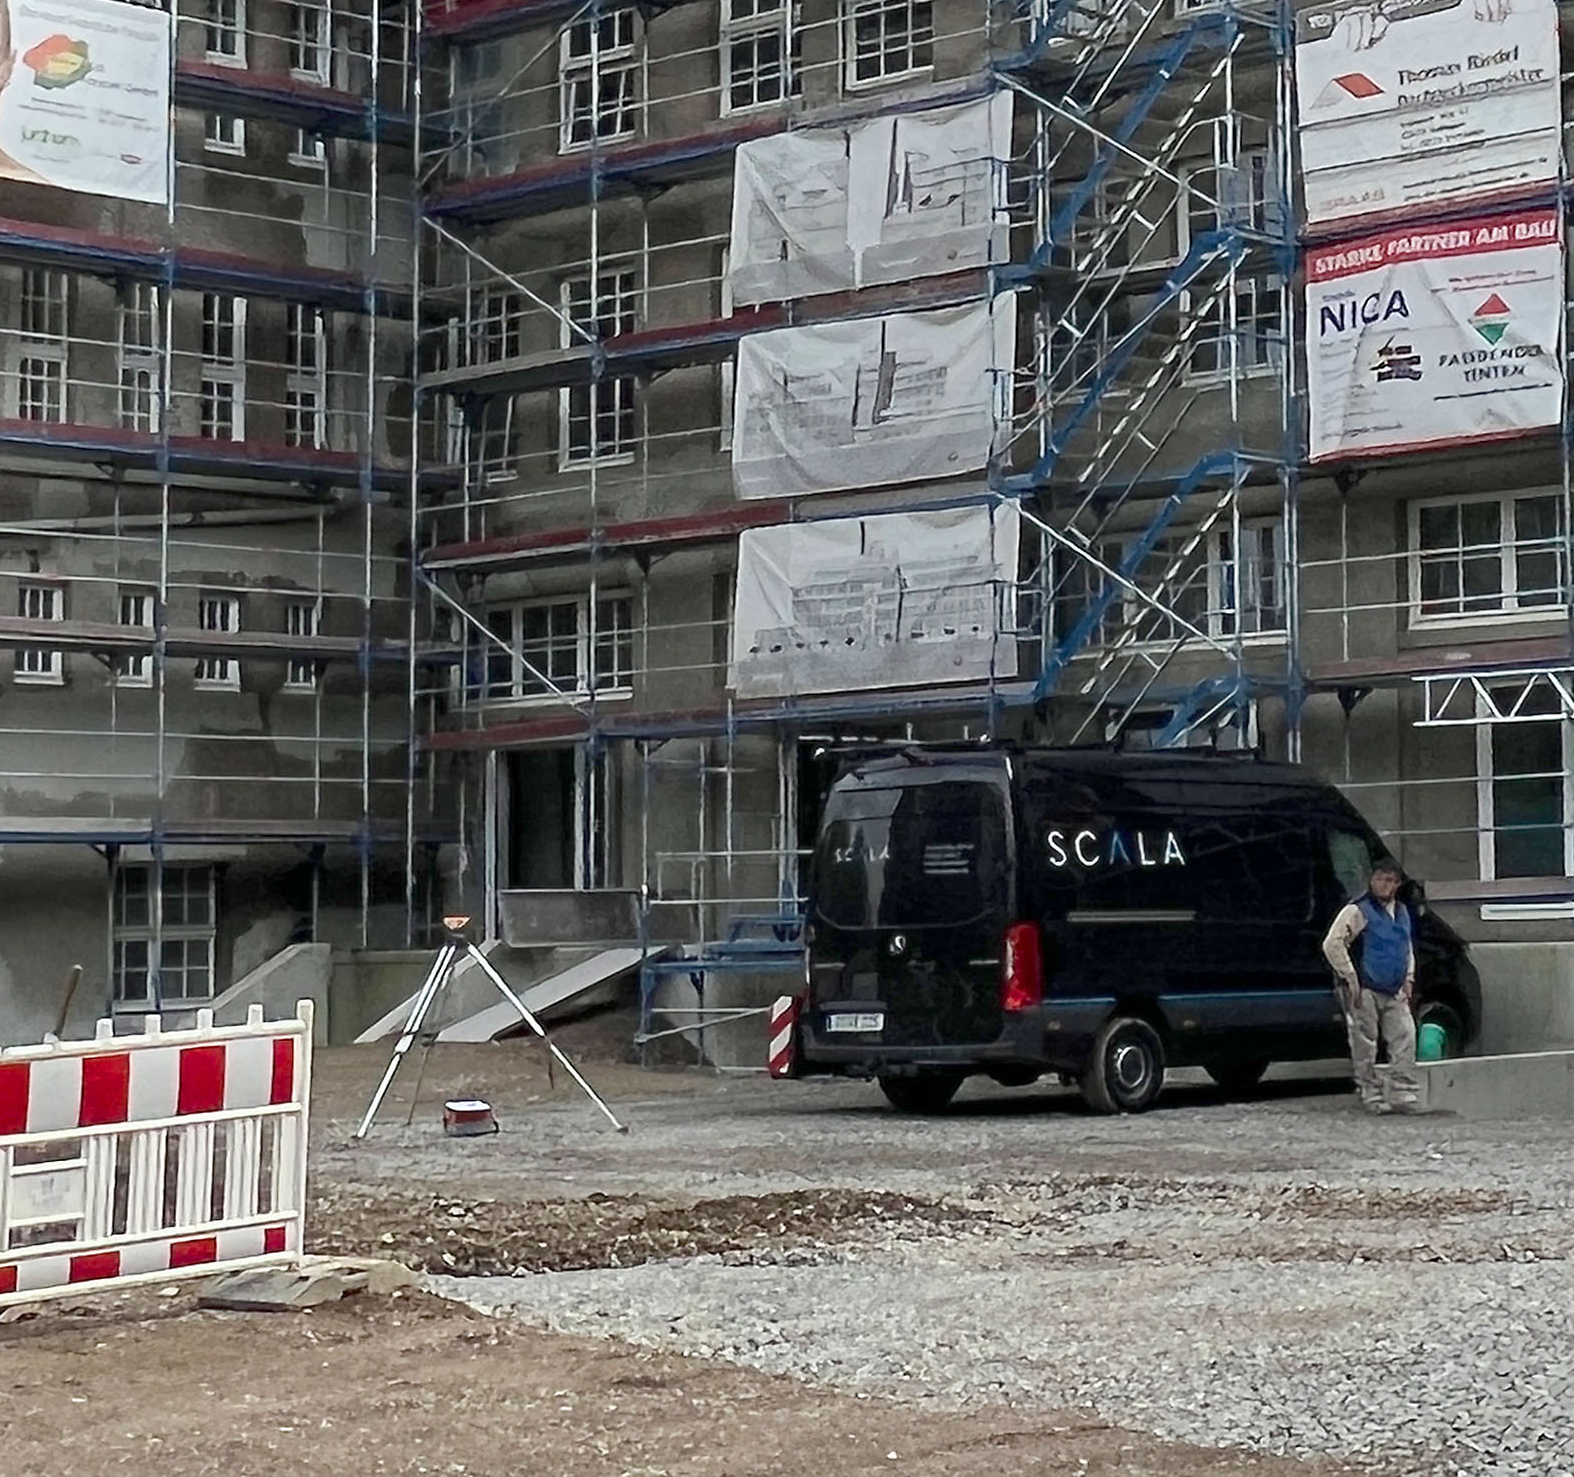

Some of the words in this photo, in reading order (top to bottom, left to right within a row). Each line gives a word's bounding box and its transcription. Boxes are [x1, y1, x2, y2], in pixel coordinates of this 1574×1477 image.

[1475, 225, 1510, 244] AM
[1319, 289, 1410, 338] NICA
[1046, 829, 1187, 868] SCALA
